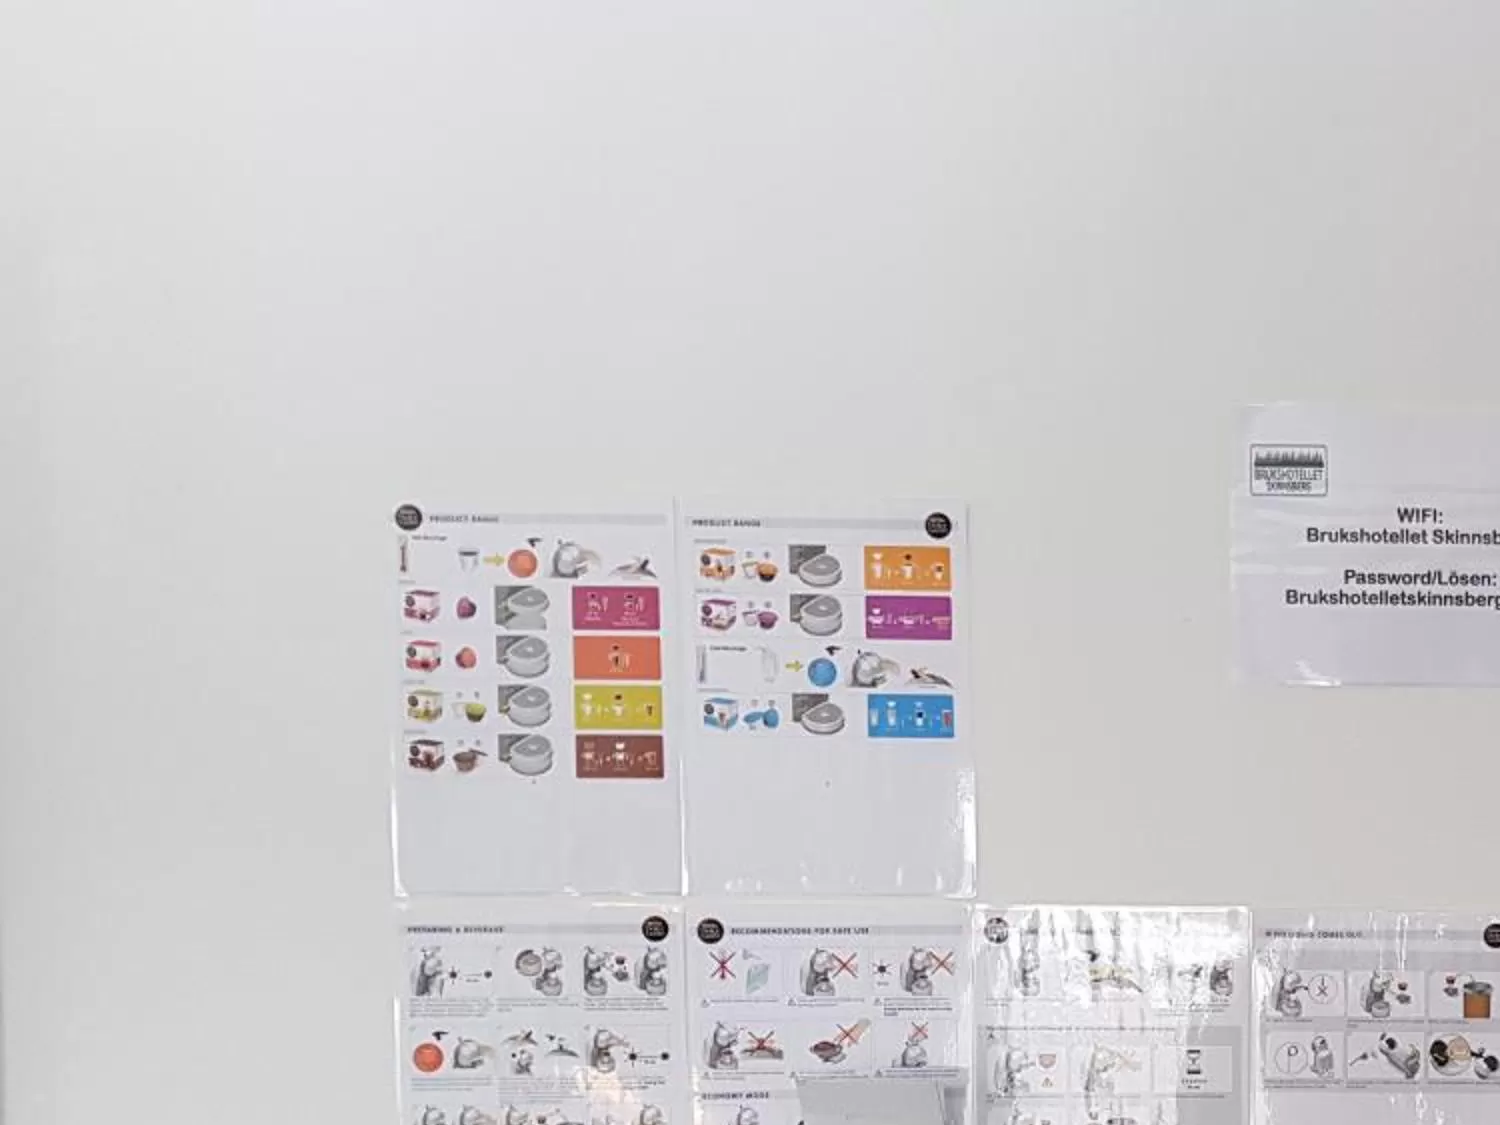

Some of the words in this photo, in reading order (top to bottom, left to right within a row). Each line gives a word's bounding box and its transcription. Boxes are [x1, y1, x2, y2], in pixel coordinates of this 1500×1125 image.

[1397, 507, 1443, 524] WIFI:
[1306, 528, 1429, 545] Brukshotellet
[1343, 570, 1498, 588] Password/Lösen:
